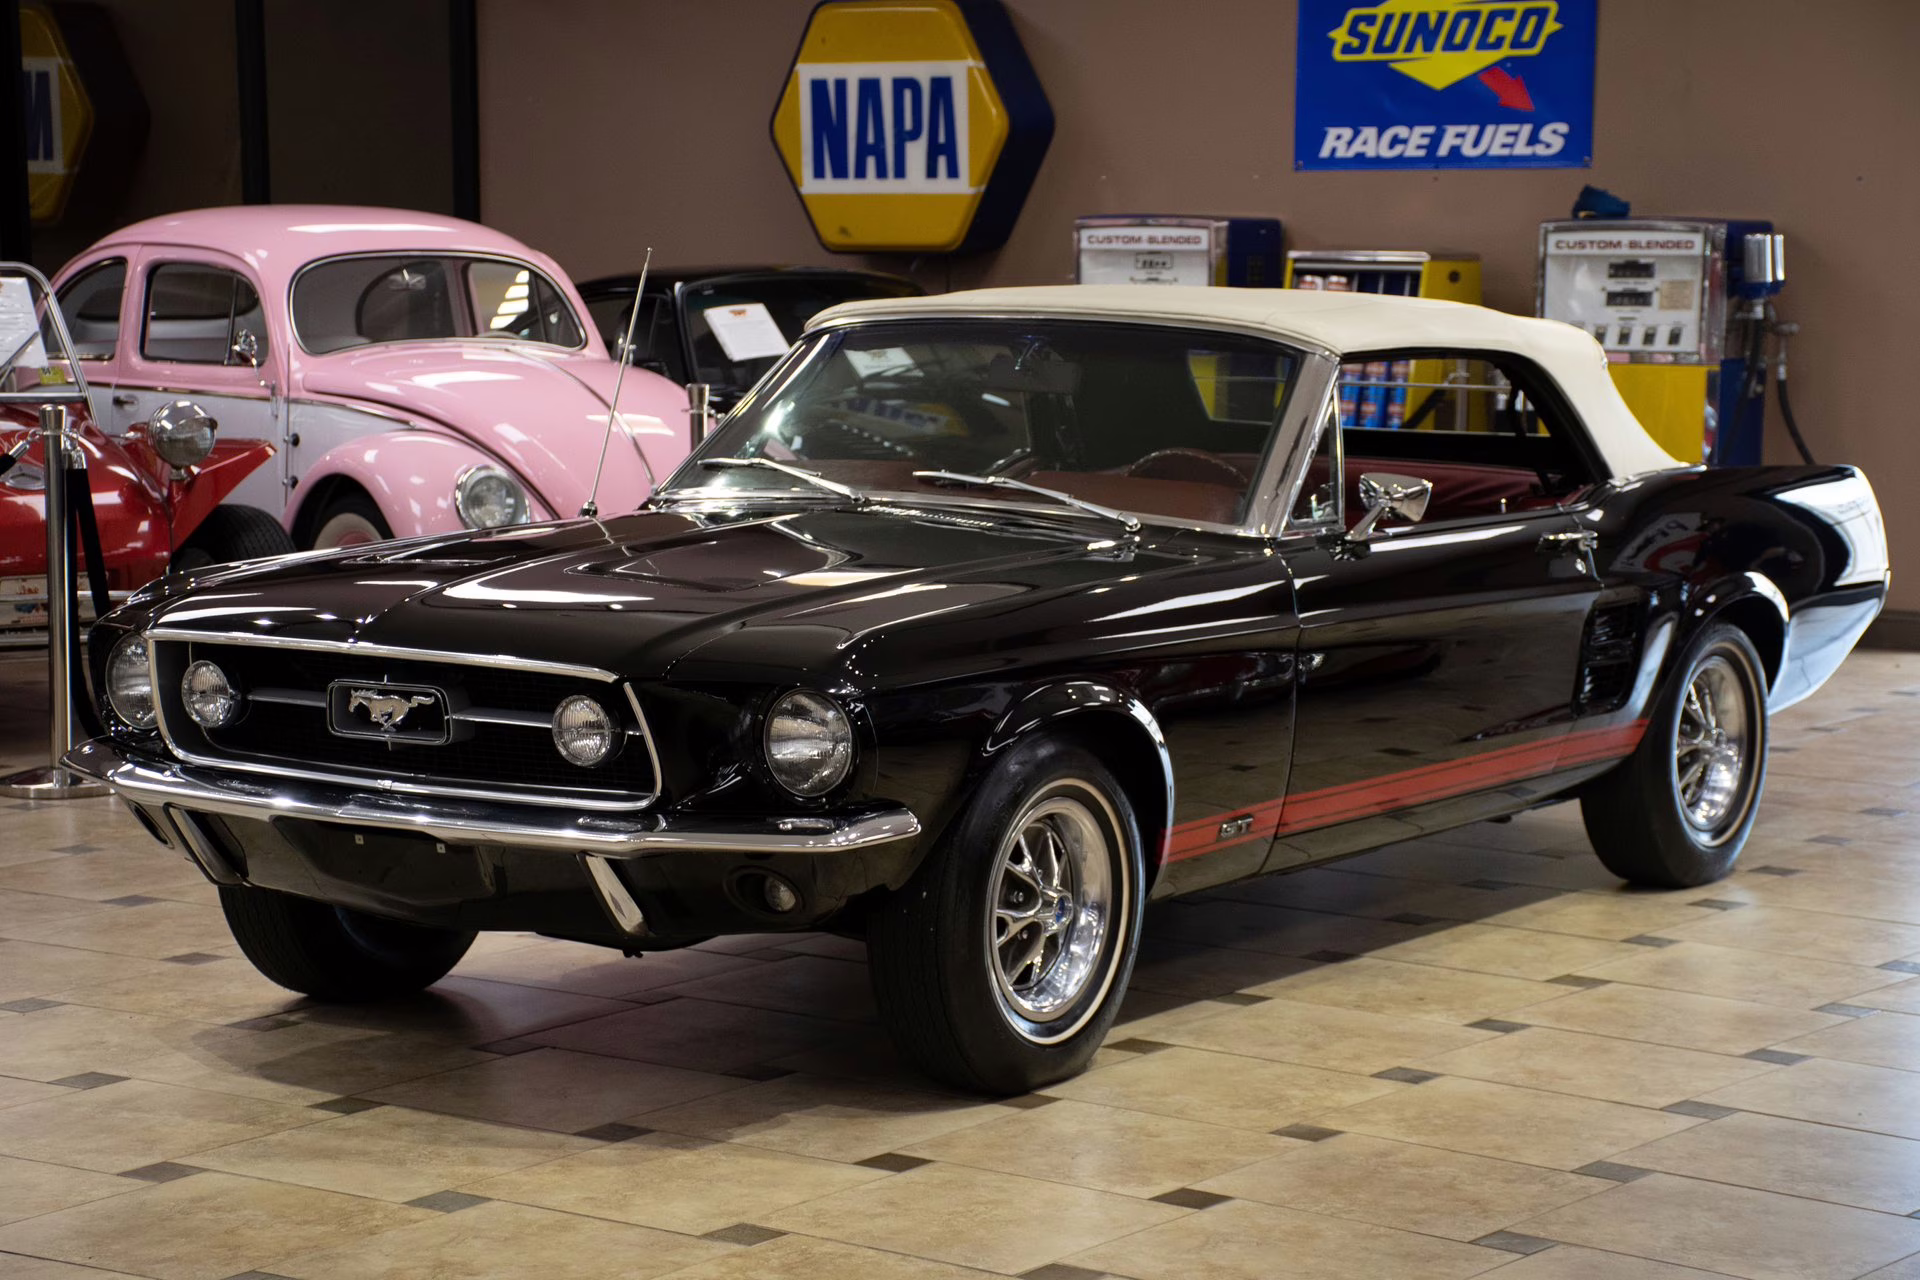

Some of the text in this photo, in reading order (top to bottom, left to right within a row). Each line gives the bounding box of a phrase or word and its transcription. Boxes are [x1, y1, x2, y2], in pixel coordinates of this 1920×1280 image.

[1340, 6, 1550, 55] SUNOCO
[810, 76, 960, 180] NAPA
[1318, 122, 1570, 159] RACE FUELS
[1220, 817, 1254, 838] GT
